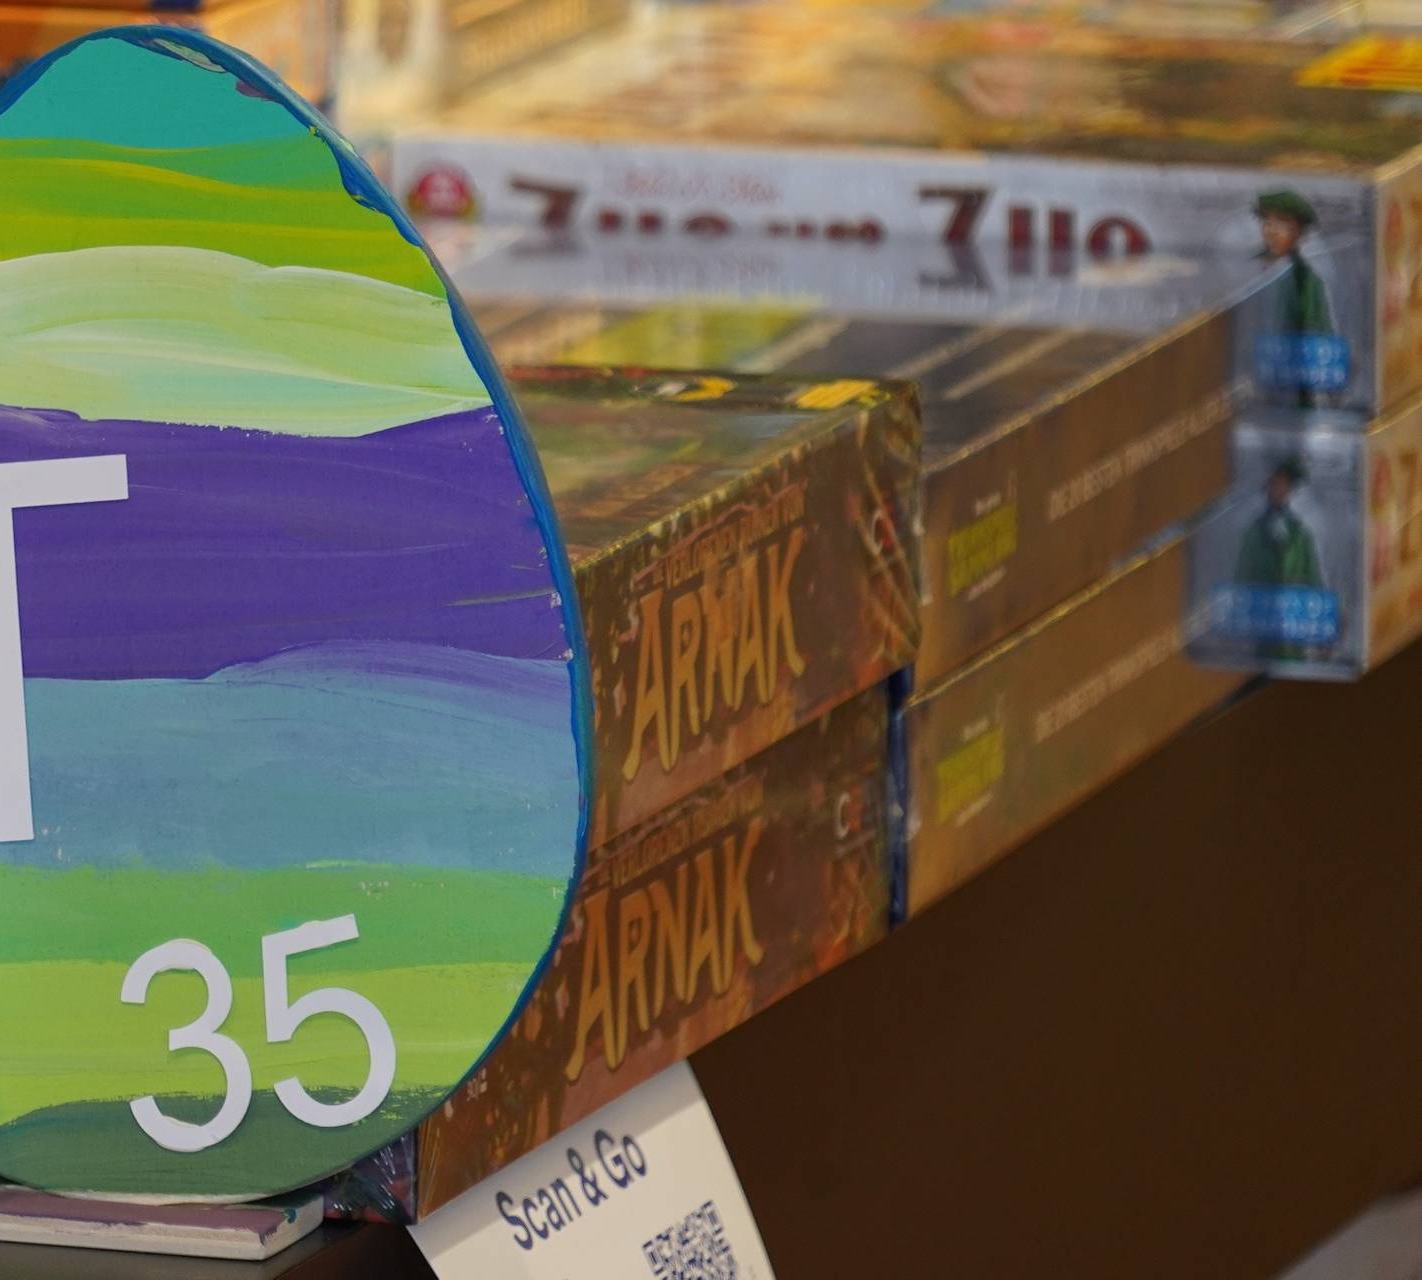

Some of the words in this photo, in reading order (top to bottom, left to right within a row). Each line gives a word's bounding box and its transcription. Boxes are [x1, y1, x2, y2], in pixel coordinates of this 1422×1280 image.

[622, 526, 808, 782] ARNAK
[119, 912, 397, 1153] 35
[564, 816, 767, 1082] ARNAK
[495, 1176, 582, 1251] Scan
[566, 1147, 609, 1208] &
[593, 1129, 647, 1189] Go
